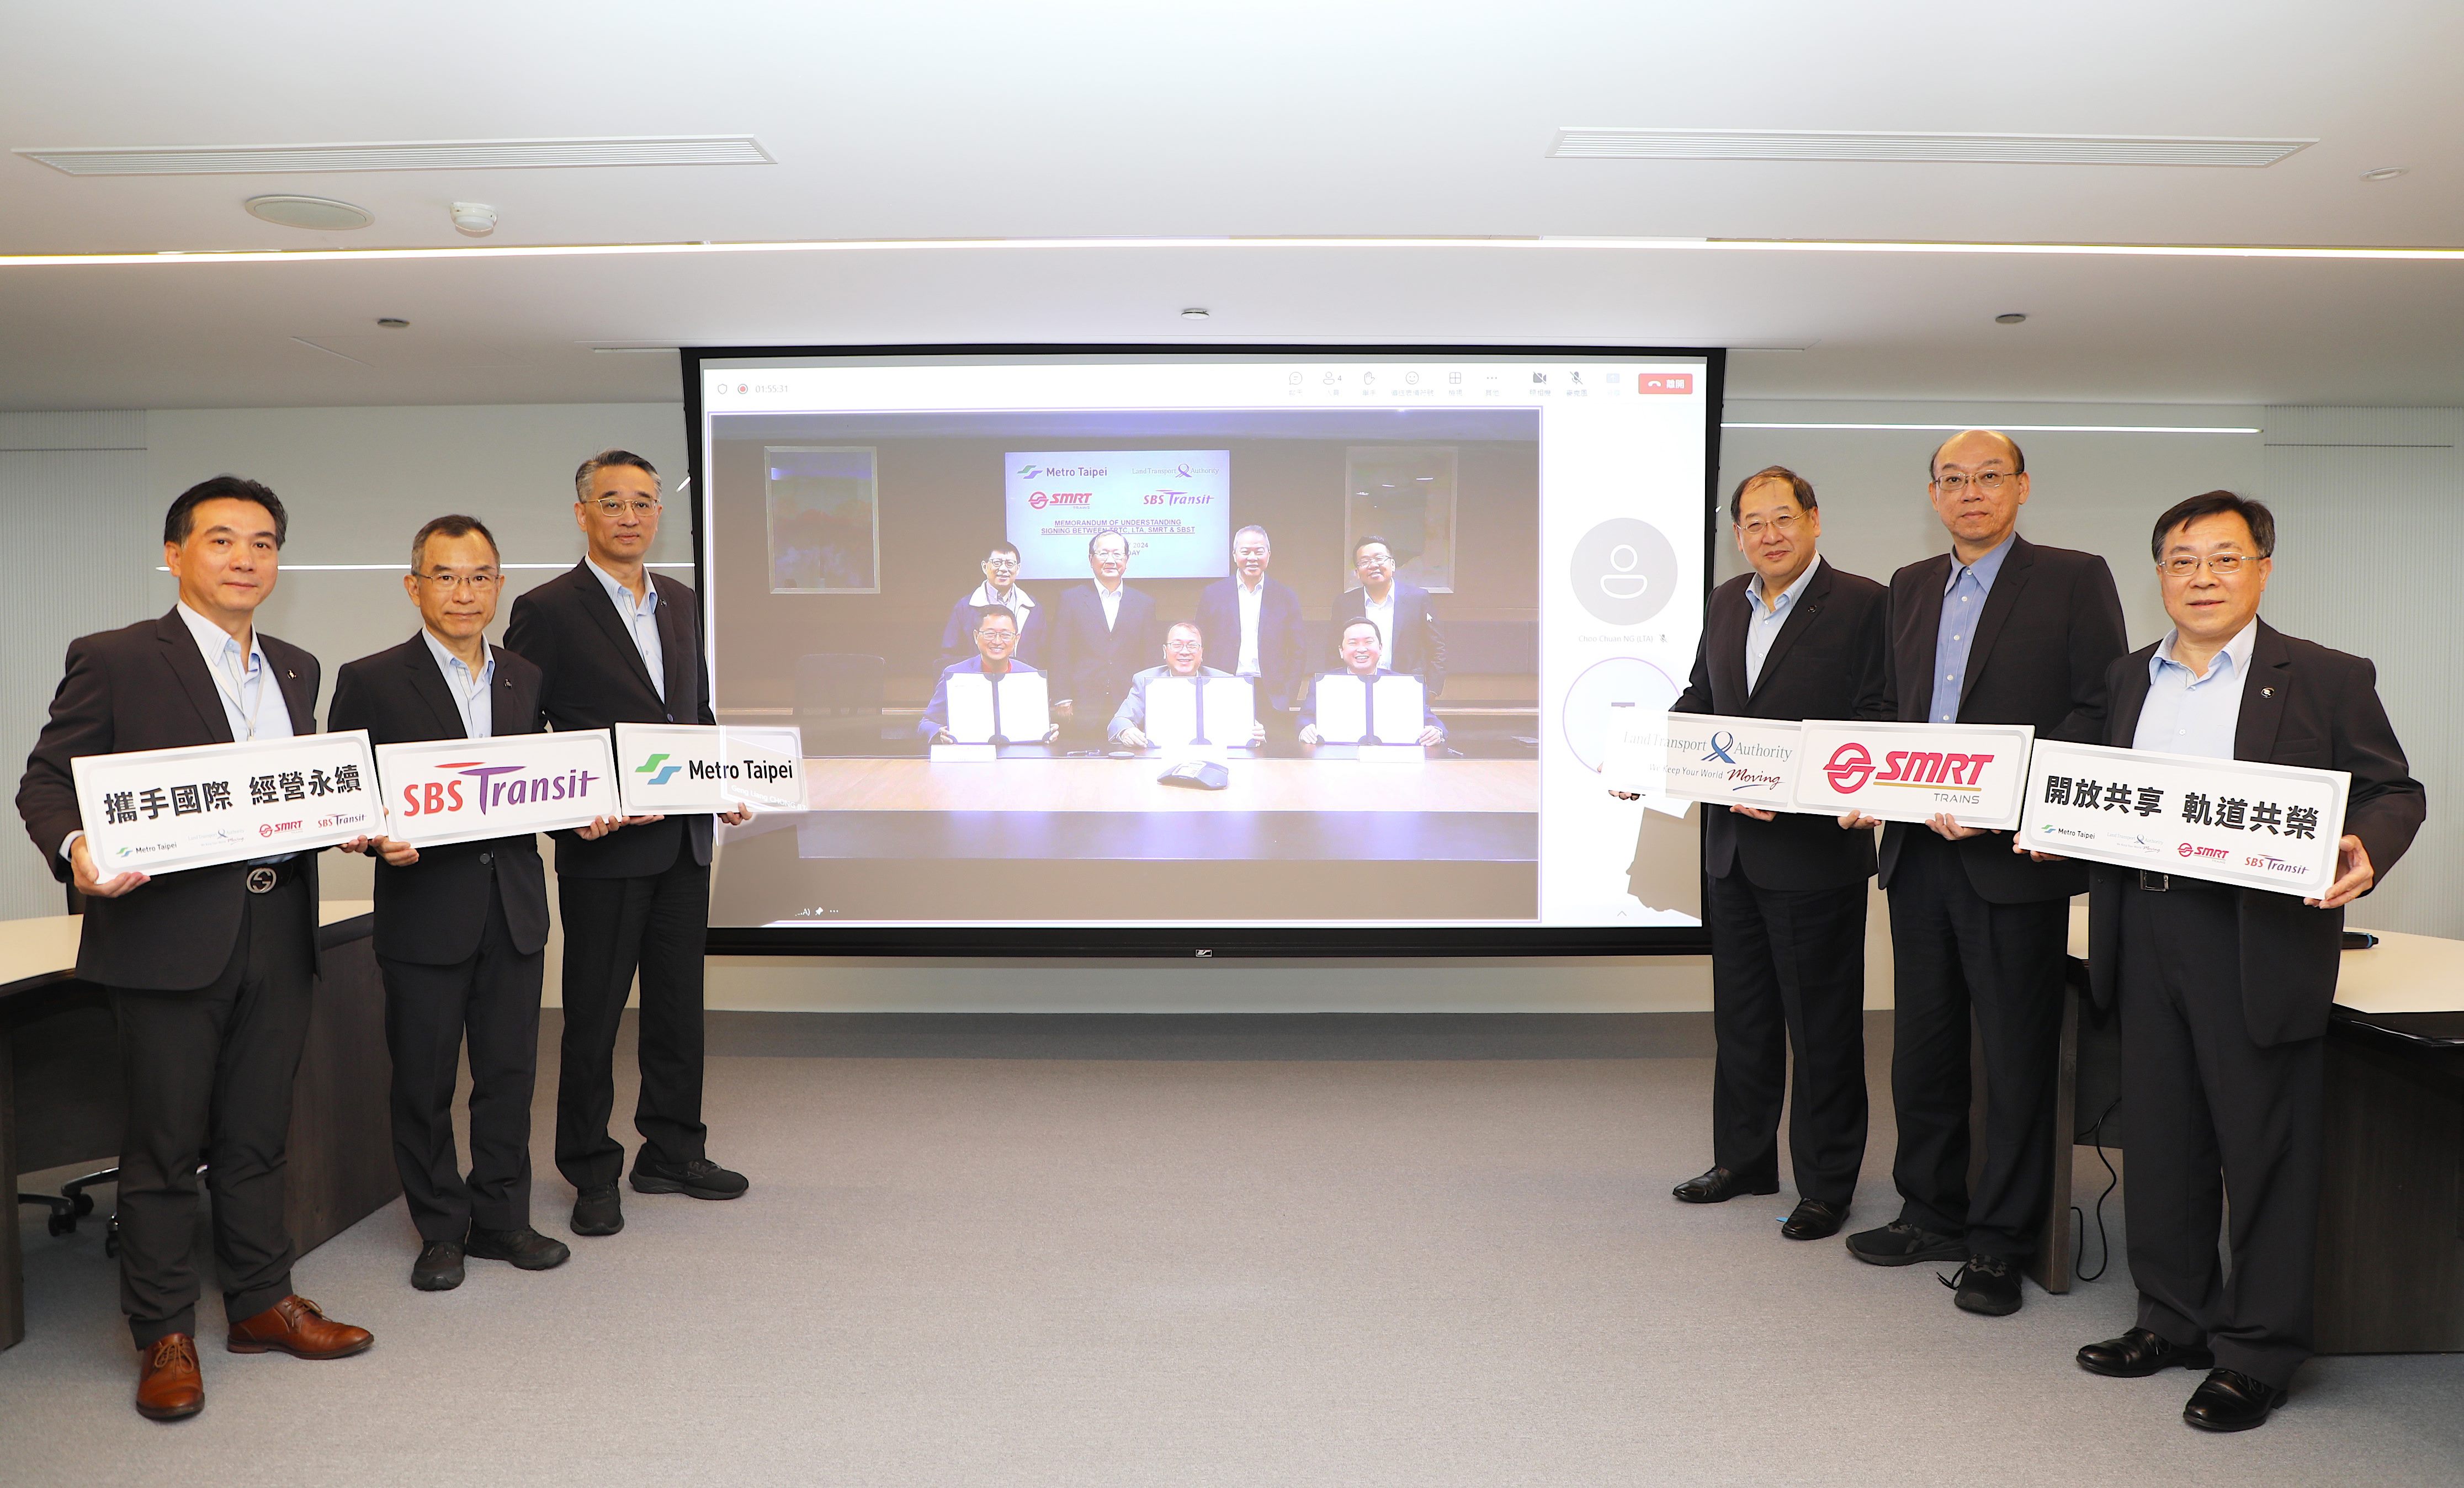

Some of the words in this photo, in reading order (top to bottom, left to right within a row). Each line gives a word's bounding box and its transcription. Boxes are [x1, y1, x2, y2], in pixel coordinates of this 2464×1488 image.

[755, 385, 788, 393] 01:55:31
[1047, 467, 1075, 477] Metro
[1078, 467, 1107, 479] Taipei
[1049, 493, 1092, 504] SMRT
[1143, 495, 1164, 504] SBS
[1163, 492, 1214, 506] Transit
[1652, 734, 1707, 753] Transport
[1734, 742, 1793, 762] Authority
[689, 760, 739, 779] Metro
[744, 760, 793, 784] Taipei
[1875, 751, 1994, 785] SMRT
[1663, 765, 1681, 777] Keep
[1682, 767, 1699, 777] Your
[1701, 769, 1724, 779] World
[1728, 769, 1782, 790] Moving
[104, 781, 233, 825] 攜手國際
[249, 764, 363, 806] 經營永續
[403, 780, 463, 817] SBS
[458, 766, 601, 815] Transit
[1934, 793, 1980, 804] TRAINS
[2045, 775, 2164, 817] 開放共享
[2181, 793, 2319, 840] 軌道共榮
[274, 820, 303, 833] SMRT
[318, 819, 333, 828] SBS
[331, 814, 367, 826] Transit
[2058, 828, 2076, 837] Metro
[2077, 831, 2096, 839] Taipei
[136, 846, 156, 854] Metro
[157, 841, 177, 851] Taipei
[2194, 847, 2229, 859] SMRT
[2244, 857, 2264, 868] SBS
[2263, 857, 2310, 874] Transit
